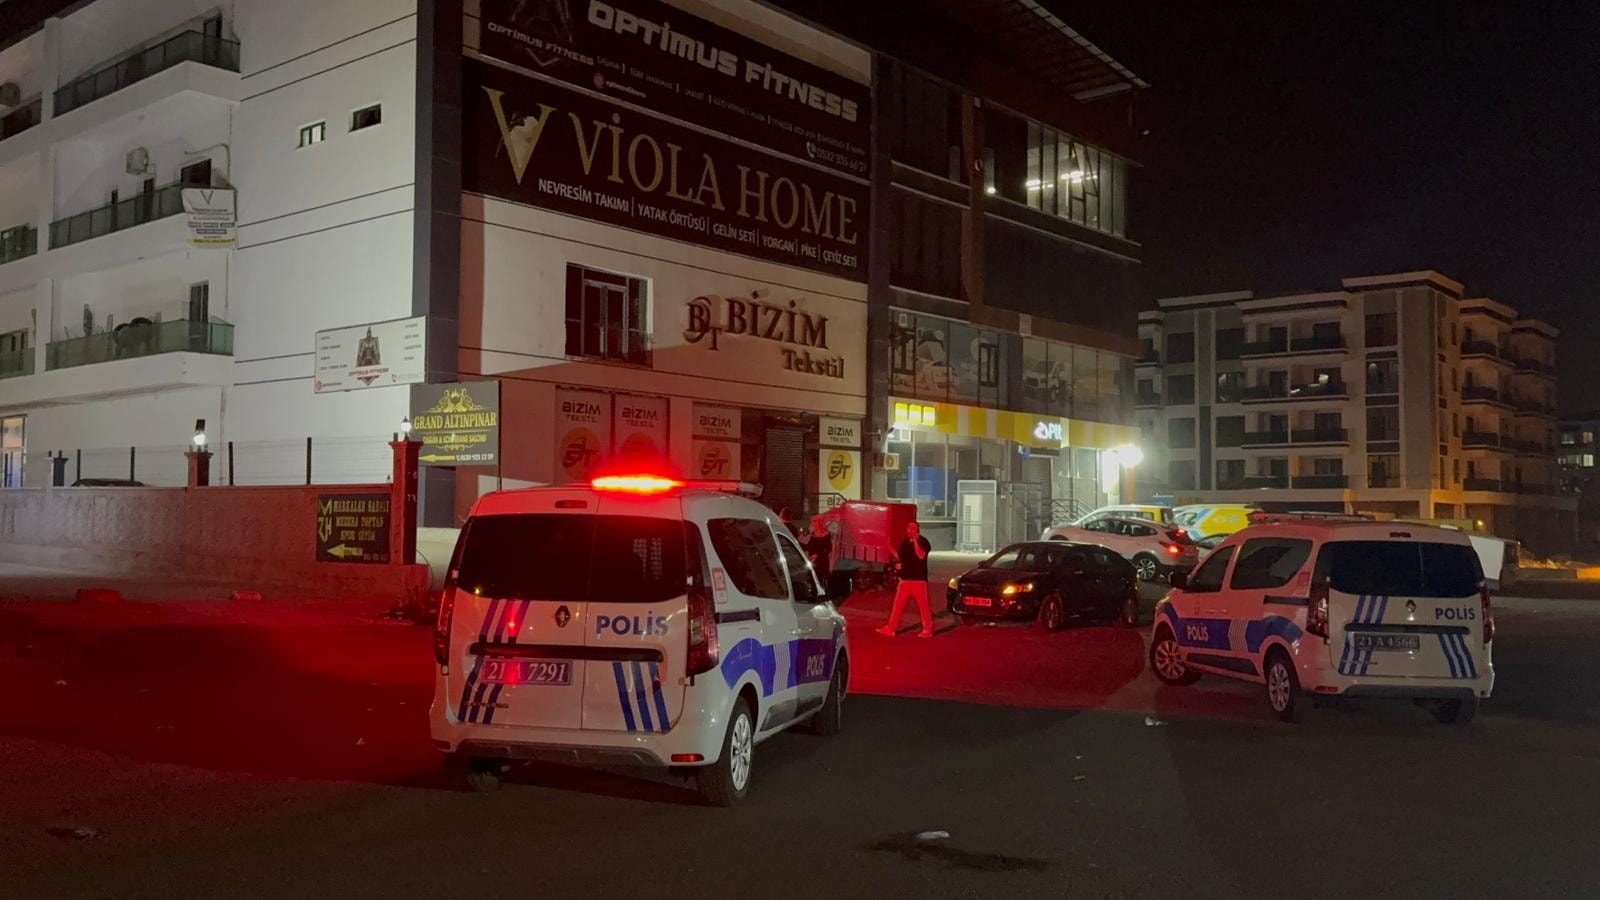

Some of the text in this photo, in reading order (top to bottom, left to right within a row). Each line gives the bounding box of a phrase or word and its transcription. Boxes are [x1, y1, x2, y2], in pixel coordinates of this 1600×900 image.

[538, 178, 593, 204] NEVRESİM
[594, 190, 630, 213] TAKIMI
[637, 203, 668, 223] YATAK
[669, 209, 706, 232] ÖRTÜSÜ
[762, 234, 795, 255] YORGAN
[736, 164, 859, 246] HOME
[724, 290, 829, 350] BİZİM
[782, 349, 844, 379] Tekstil
[414, 412, 497, 430] GRAND ALTINPINAR
[596, 610, 669, 637] POLİS
[1435, 604, 1476, 620] POLİS
[488, 661, 506, 680] 21
[527, 662, 566, 682] 7291
